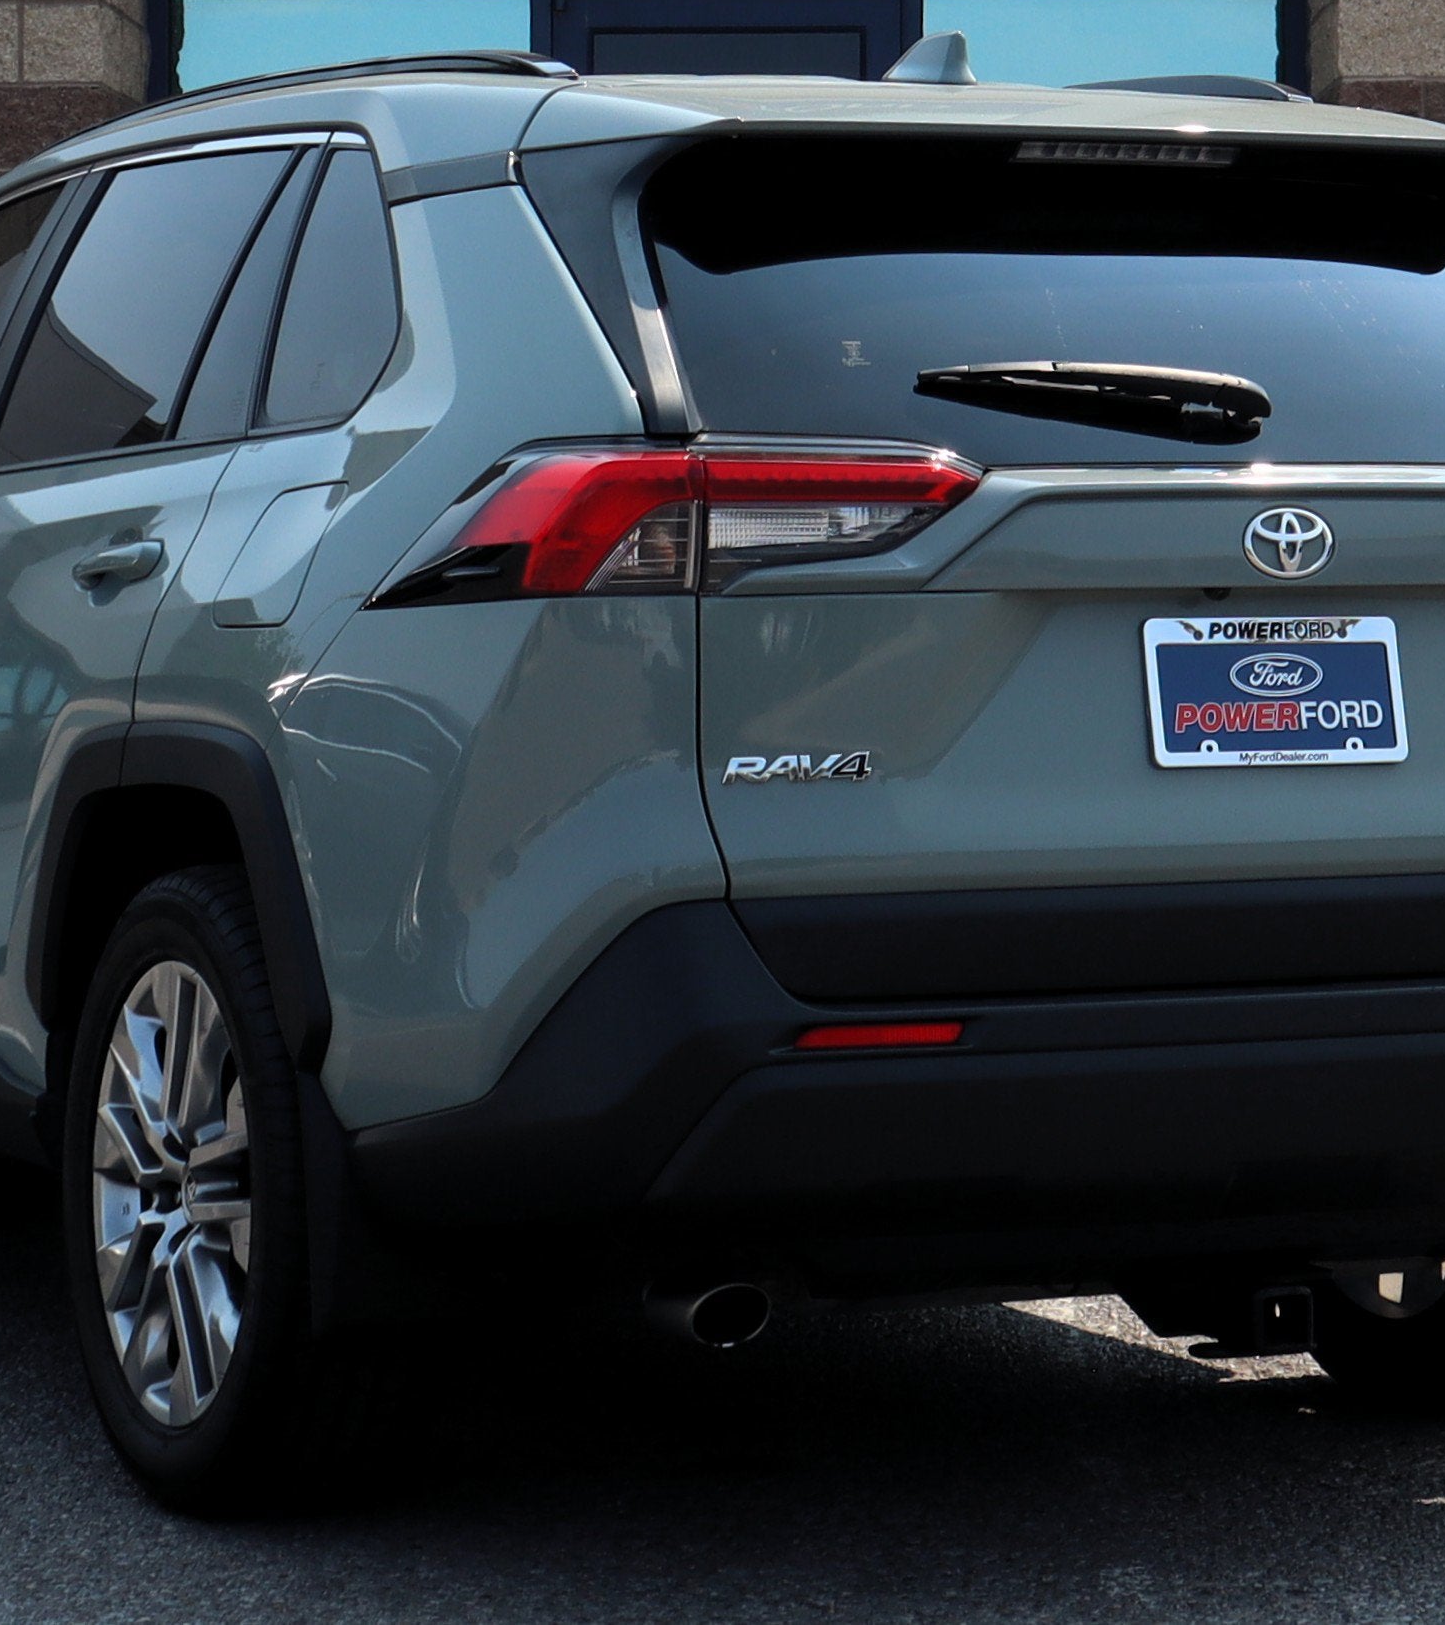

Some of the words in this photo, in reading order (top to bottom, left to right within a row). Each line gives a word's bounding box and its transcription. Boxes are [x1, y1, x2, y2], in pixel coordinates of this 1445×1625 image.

[1208, 621, 1335, 640] POWERFORD
[1249, 660, 1304, 687] Ford
[1174, 700, 1384, 734] POWERFORD
[722, 750, 872, 784] RAV4
[1239, 751, 1329, 765] MyFordDealer.com
